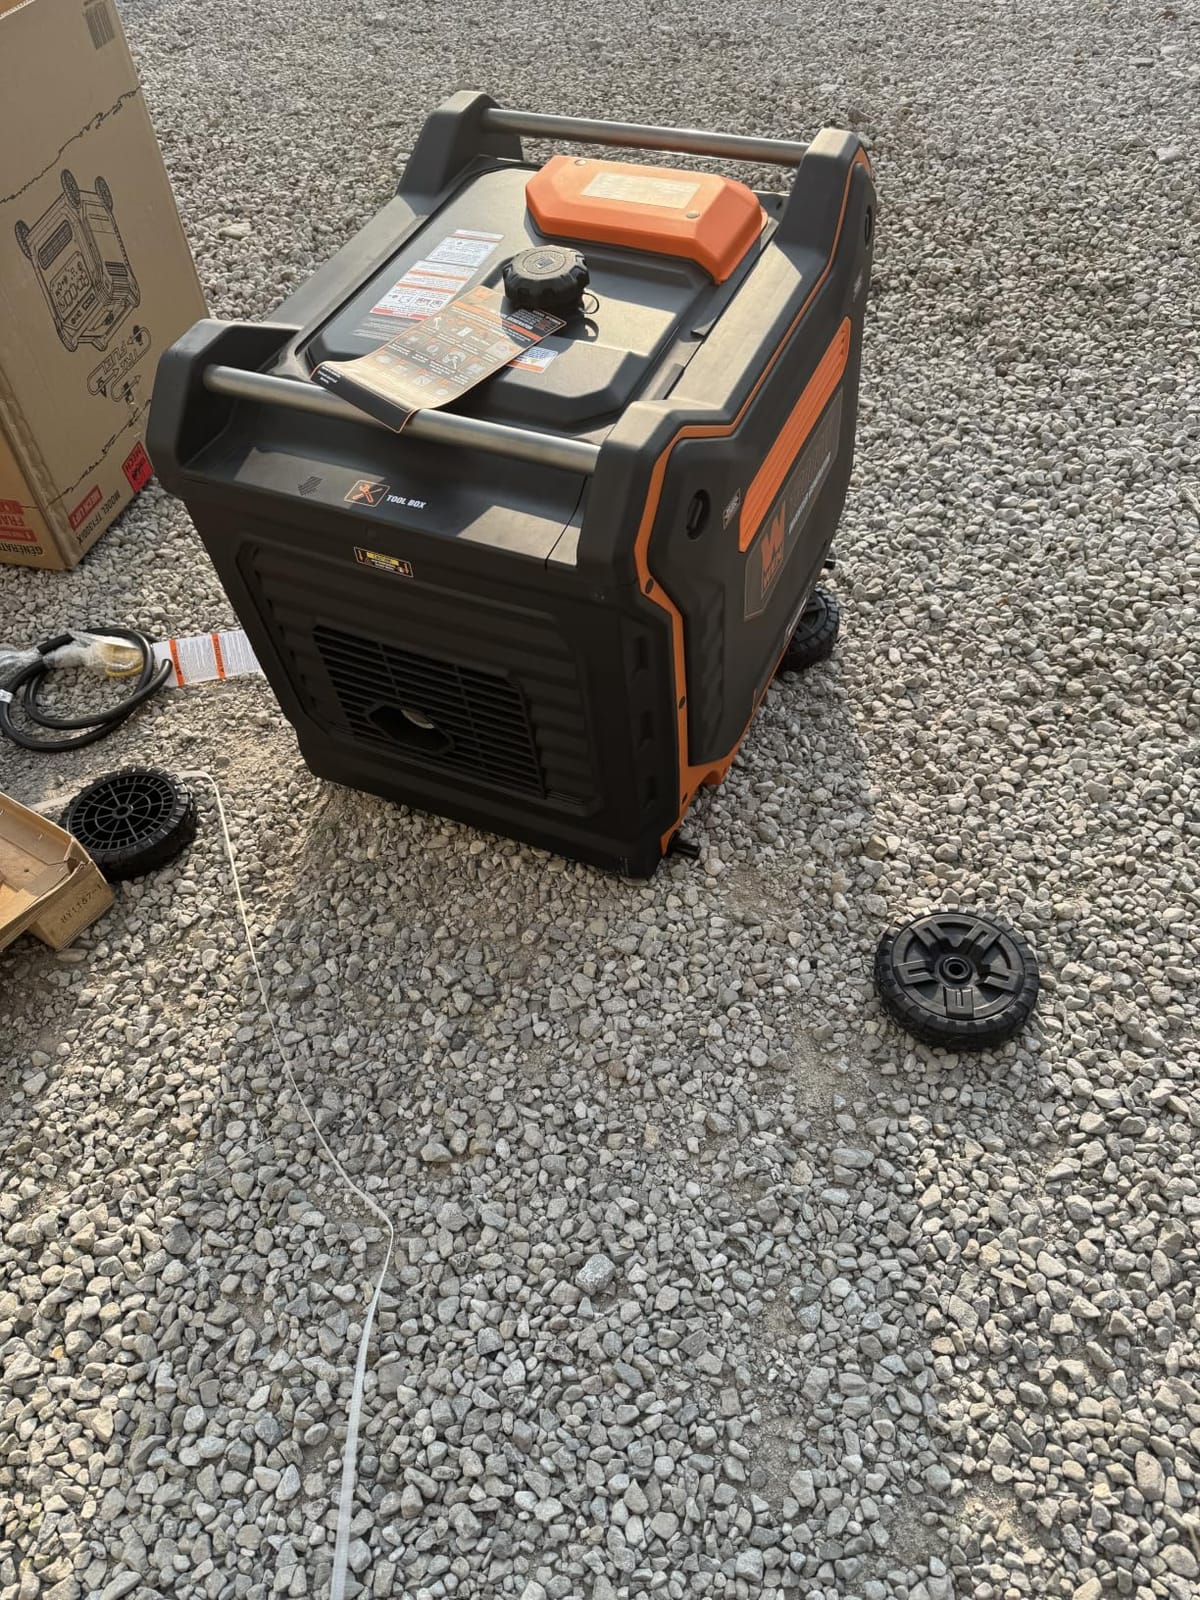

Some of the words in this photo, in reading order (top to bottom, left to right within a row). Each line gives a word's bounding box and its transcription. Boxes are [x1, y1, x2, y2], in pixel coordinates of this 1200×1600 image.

[101, 489, 120, 514] MODEL
[386, 494, 407, 505] TOOL
[408, 500, 427, 509] BOX
